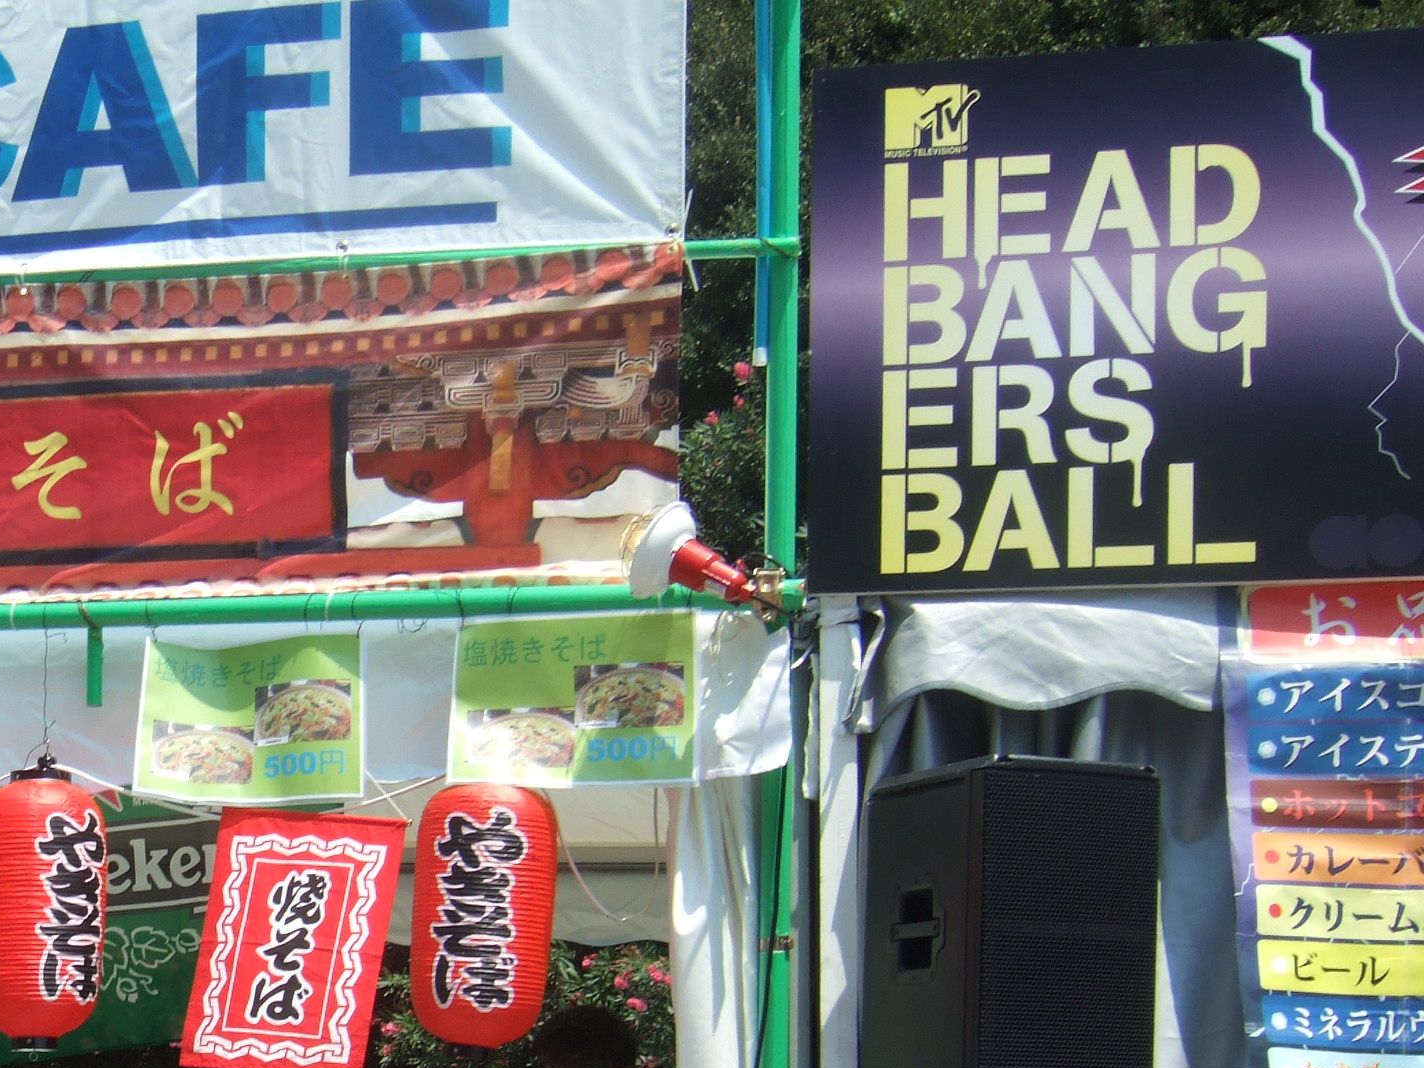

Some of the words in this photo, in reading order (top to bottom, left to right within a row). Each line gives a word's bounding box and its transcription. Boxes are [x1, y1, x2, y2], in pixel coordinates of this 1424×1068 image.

[884, 83, 981, 151] MTV
[884, 149, 912, 159] MUSIC
[883, 143, 1262, 272] HEAD
[882, 246, 1268, 372] BANG
[881, 358, 1155, 485] ERS
[879, 462, 1257, 575] BALL
[153, 654, 282, 688] 塩焼きそば
[464, 632, 607, 667] 塩焼きそば
[264, 749, 345, 780] 500円
[586, 735, 680, 763] 500円
[430, 805, 530, 1013] やきそば
[243, 868, 332, 1027] 焼そば
[1292, 952, 1391, 987] ビール
